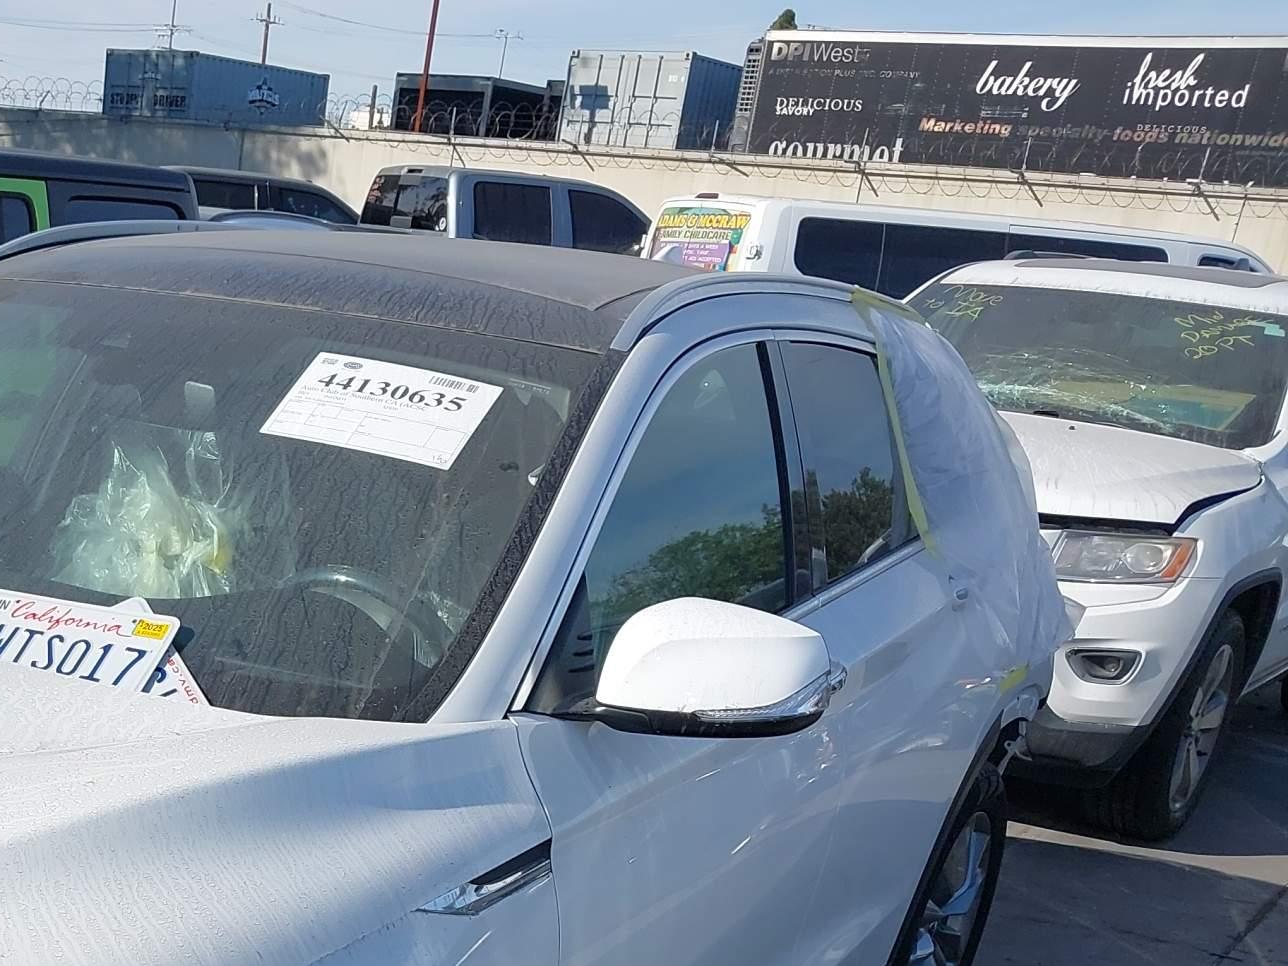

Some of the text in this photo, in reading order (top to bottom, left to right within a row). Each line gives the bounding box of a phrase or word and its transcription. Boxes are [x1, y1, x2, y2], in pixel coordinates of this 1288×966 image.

[975, 60, 1081, 112] bakery
[1132, 52, 1205, 98] fresh
[776, 97, 863, 112] DELICIOUS
[1122, 82, 1251, 111] imported
[775, 107, 814, 116] SAVORY
[919, 117, 1012, 137] Marketing
[1112, 126, 1169, 143] foods
[1136, 124, 1208, 134] DELICIOUS
[684, 230, 731, 240] CHILDCARE
[317, 373, 467, 412] 44130635
[11, 598, 133, 638] California
[142, 622, 165, 632] 2025
